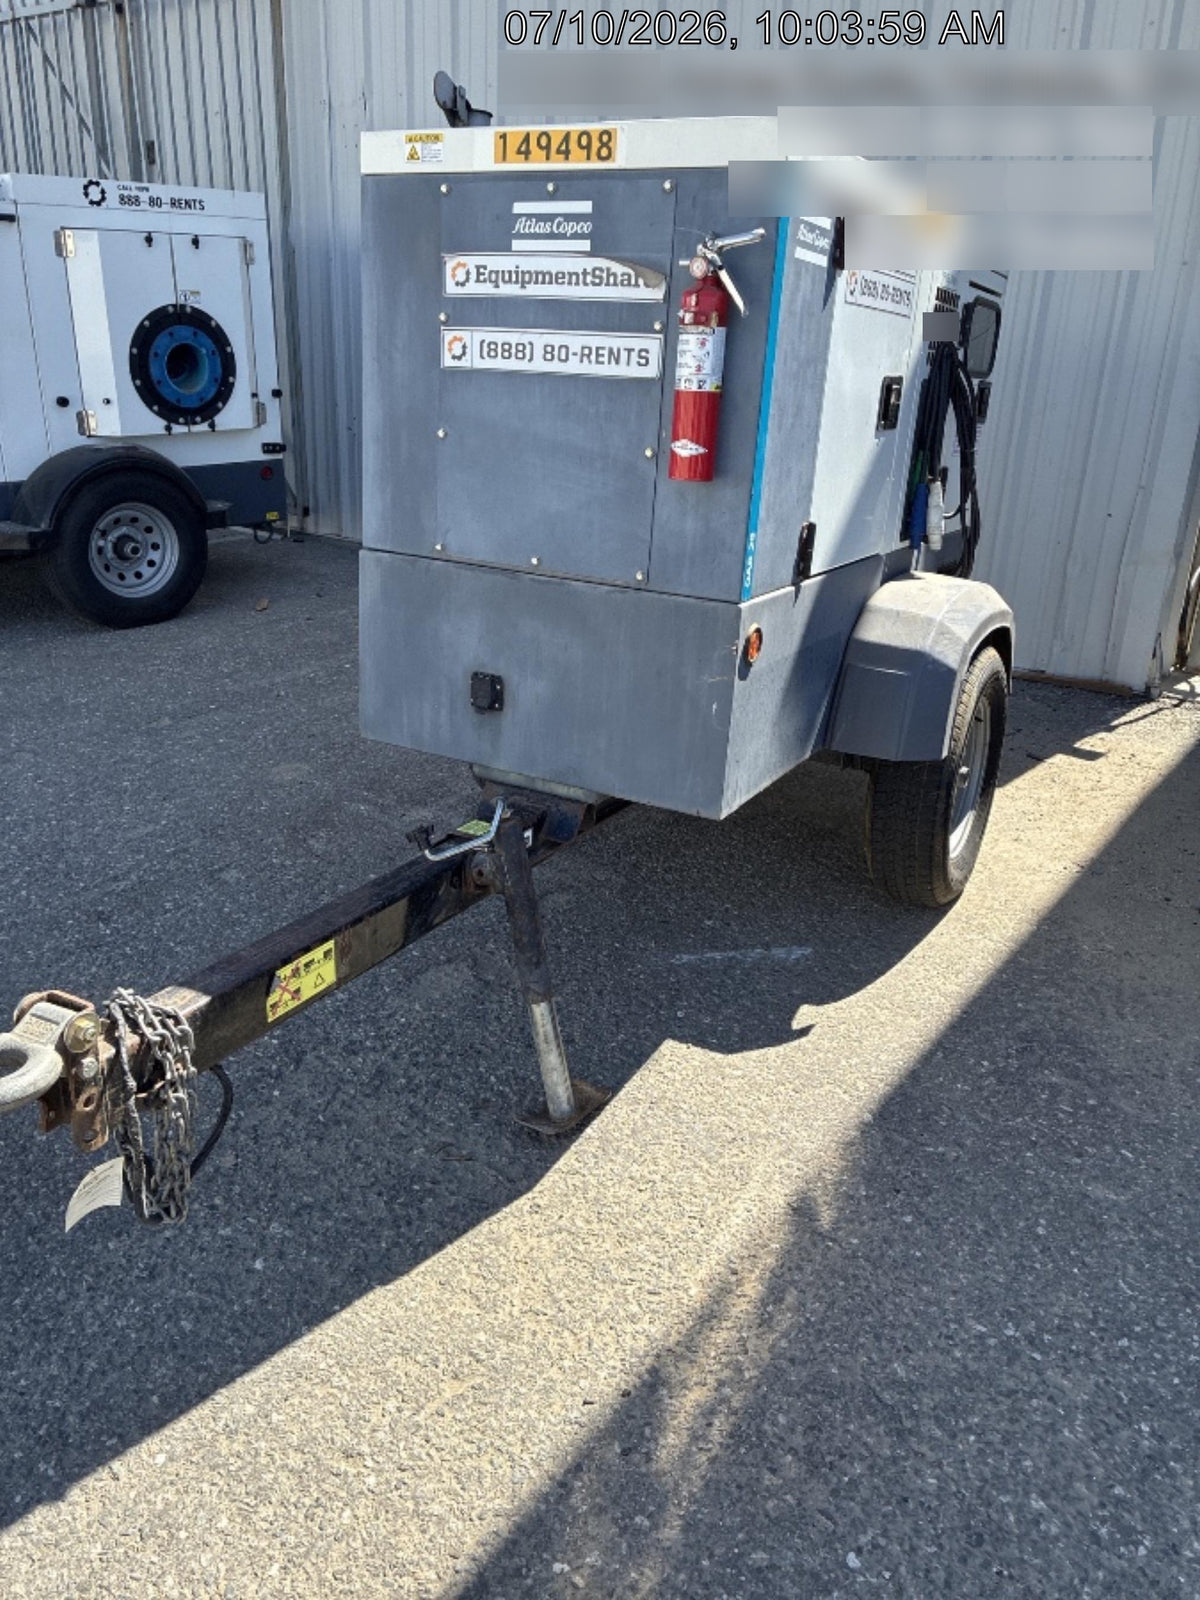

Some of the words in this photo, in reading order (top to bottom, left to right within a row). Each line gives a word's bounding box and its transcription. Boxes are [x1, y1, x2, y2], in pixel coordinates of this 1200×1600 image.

[498, 129, 613, 162] 149498
[118, 193, 206, 211] 888-80-RENTS
[511, 216, 551, 234] Atlas
[552, 216, 593, 237] Copco
[474, 264, 650, 289] EquipmentShar
[479, 339, 534, 362] (888)
[543, 344, 650, 367] 80-RENTS
